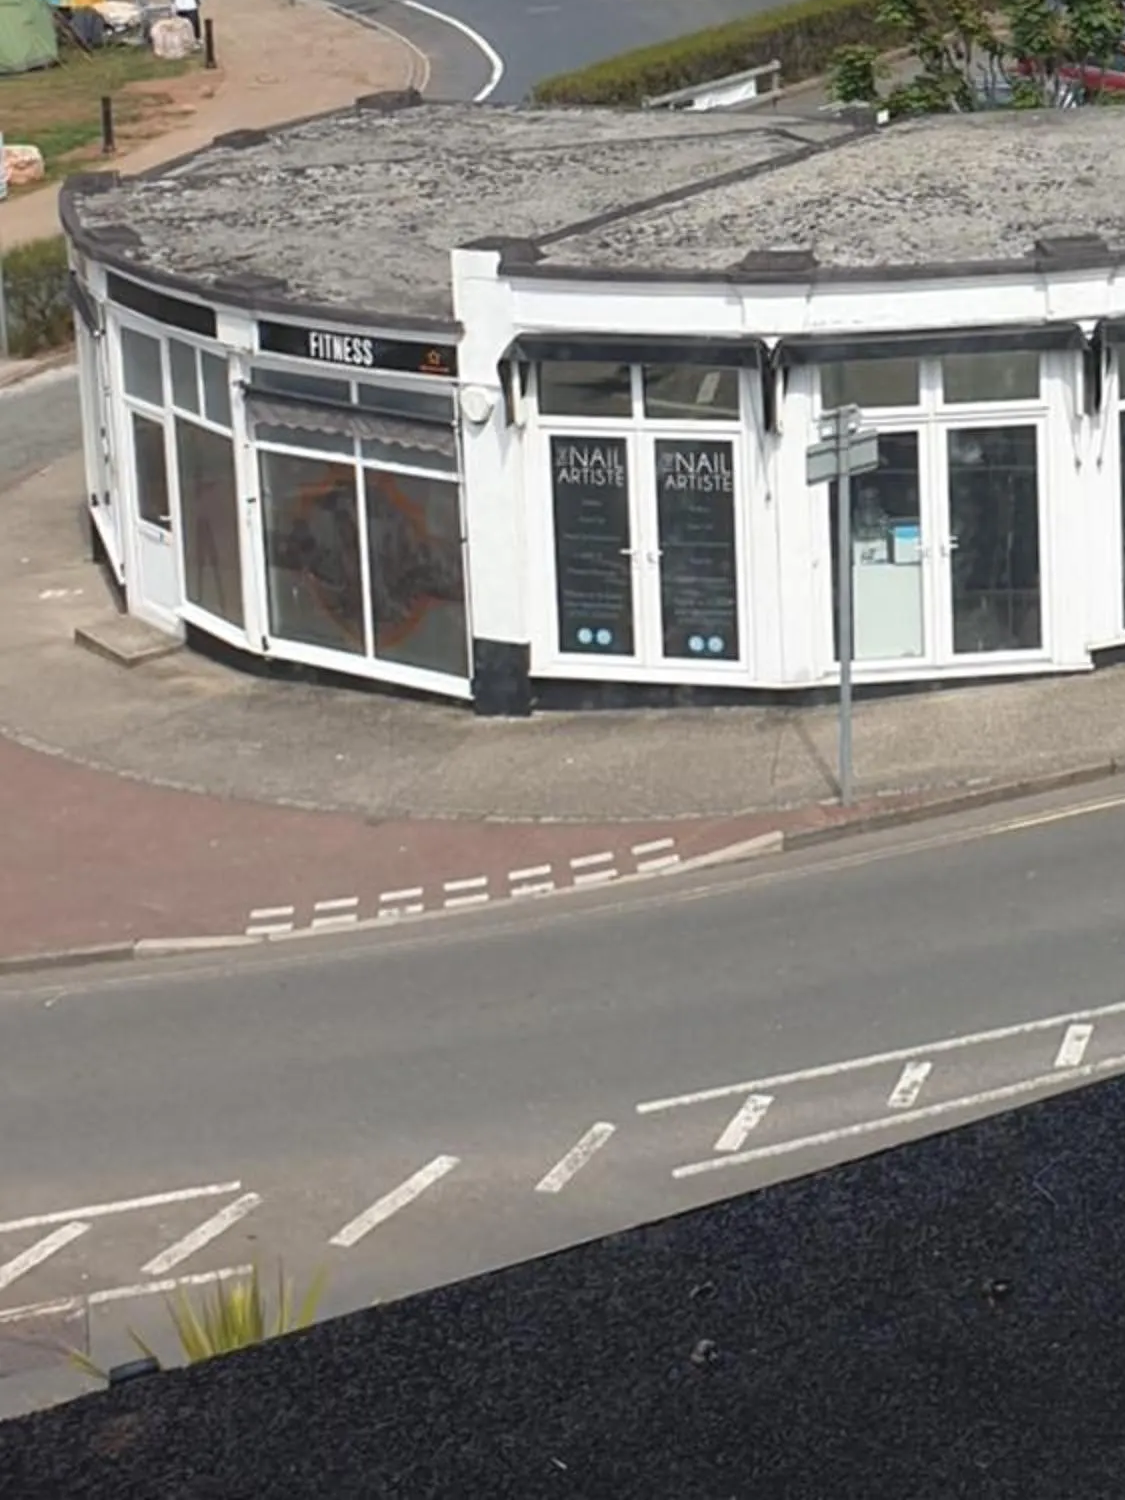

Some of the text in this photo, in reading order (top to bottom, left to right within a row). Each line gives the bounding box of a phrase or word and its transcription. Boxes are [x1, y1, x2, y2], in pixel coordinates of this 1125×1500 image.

[308, 331, 373, 366] FITNESS
[569, 445, 622, 470] NAIL
[675, 451, 730, 476] NAIL
[557, 467, 624, 488] ARTISTE
[664, 473, 733, 493] ARTISTE
